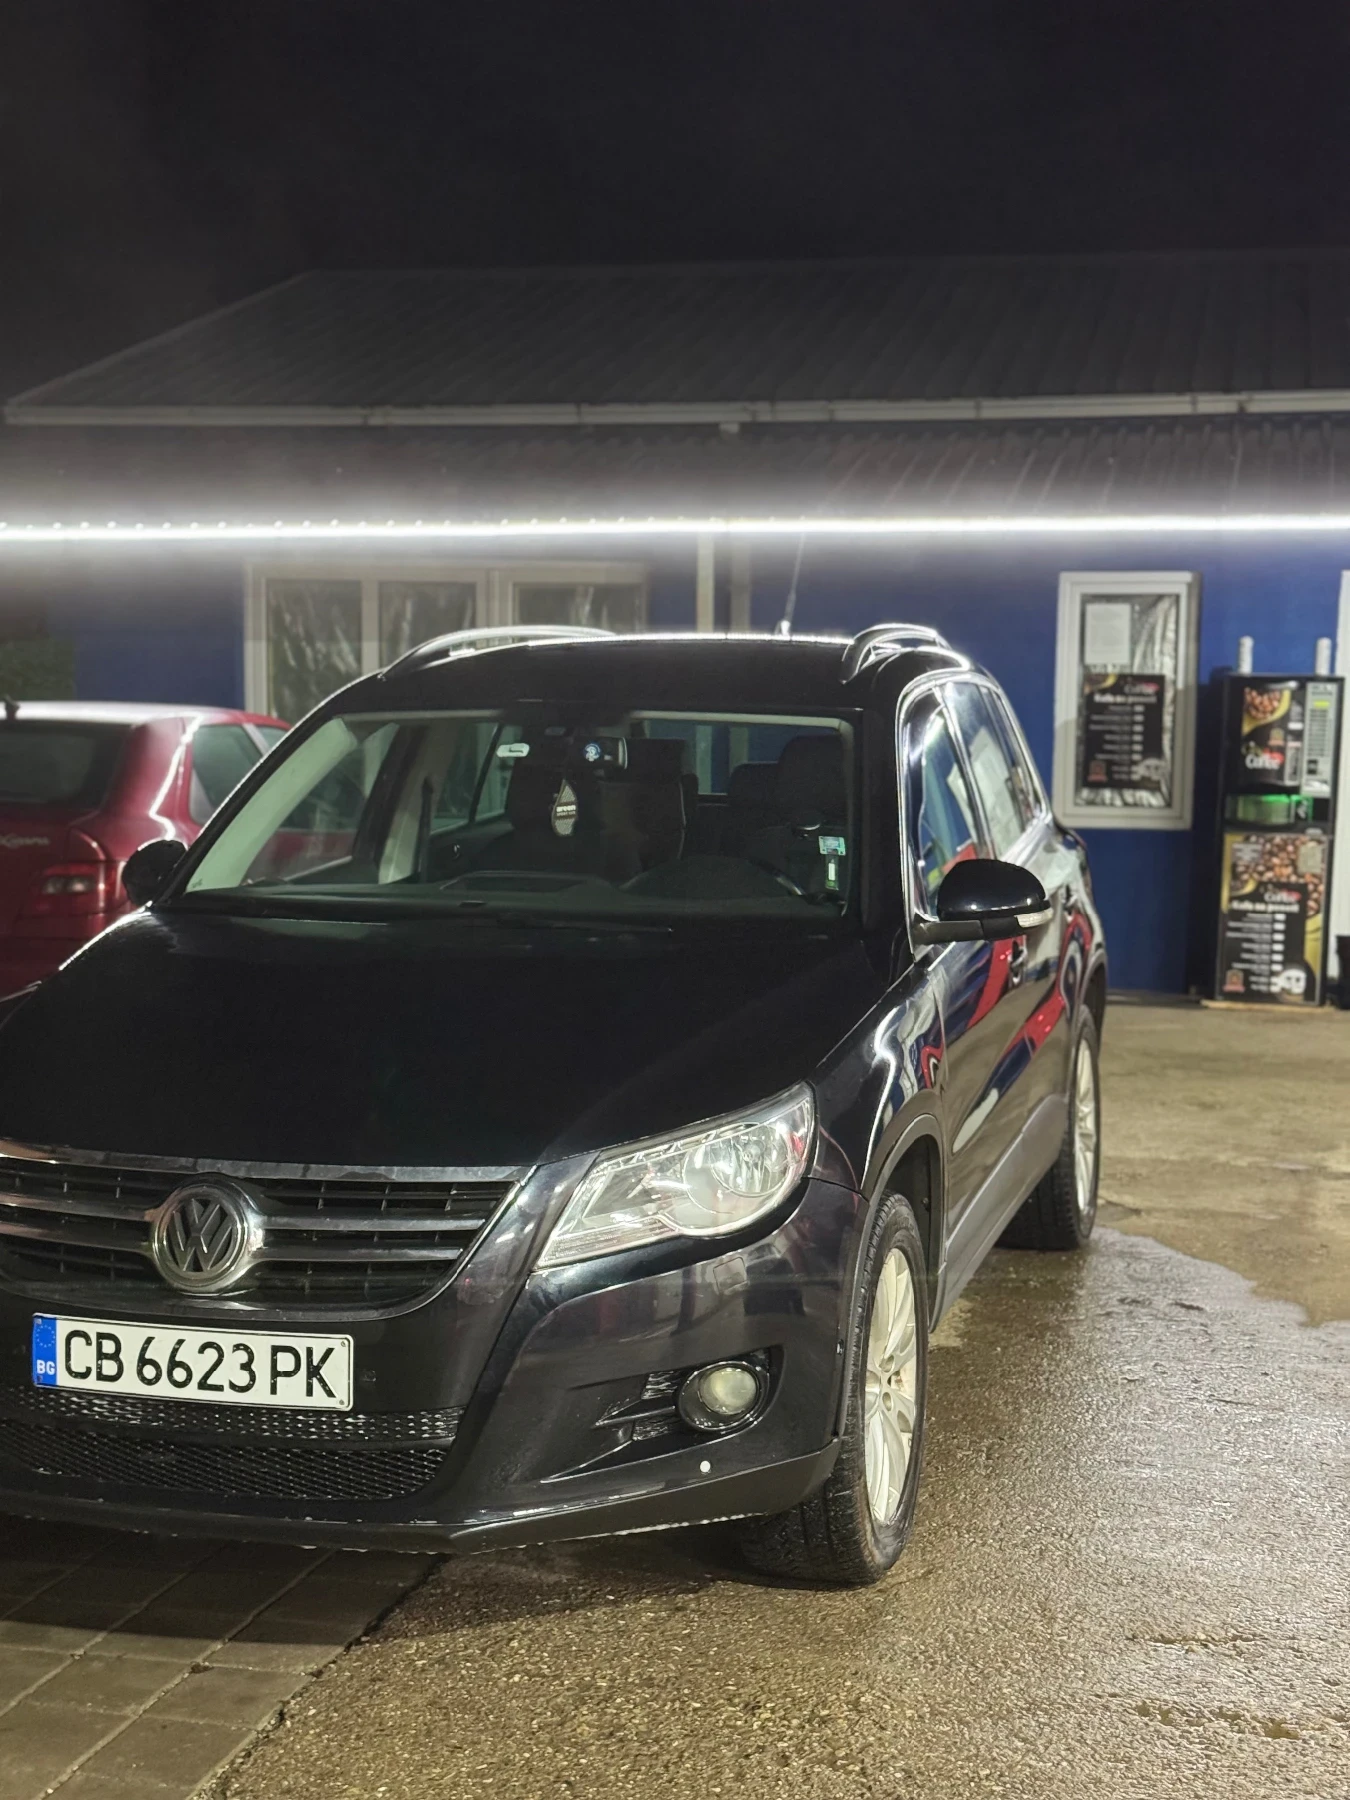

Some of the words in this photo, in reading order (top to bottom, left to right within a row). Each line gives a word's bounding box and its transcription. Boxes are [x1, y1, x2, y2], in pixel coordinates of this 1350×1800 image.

[36, 1359, 56, 1376] BG
[64, 1329, 125, 1383] CB
[136, 1336, 257, 1394] 6623
[269, 1345, 338, 1399] PK
